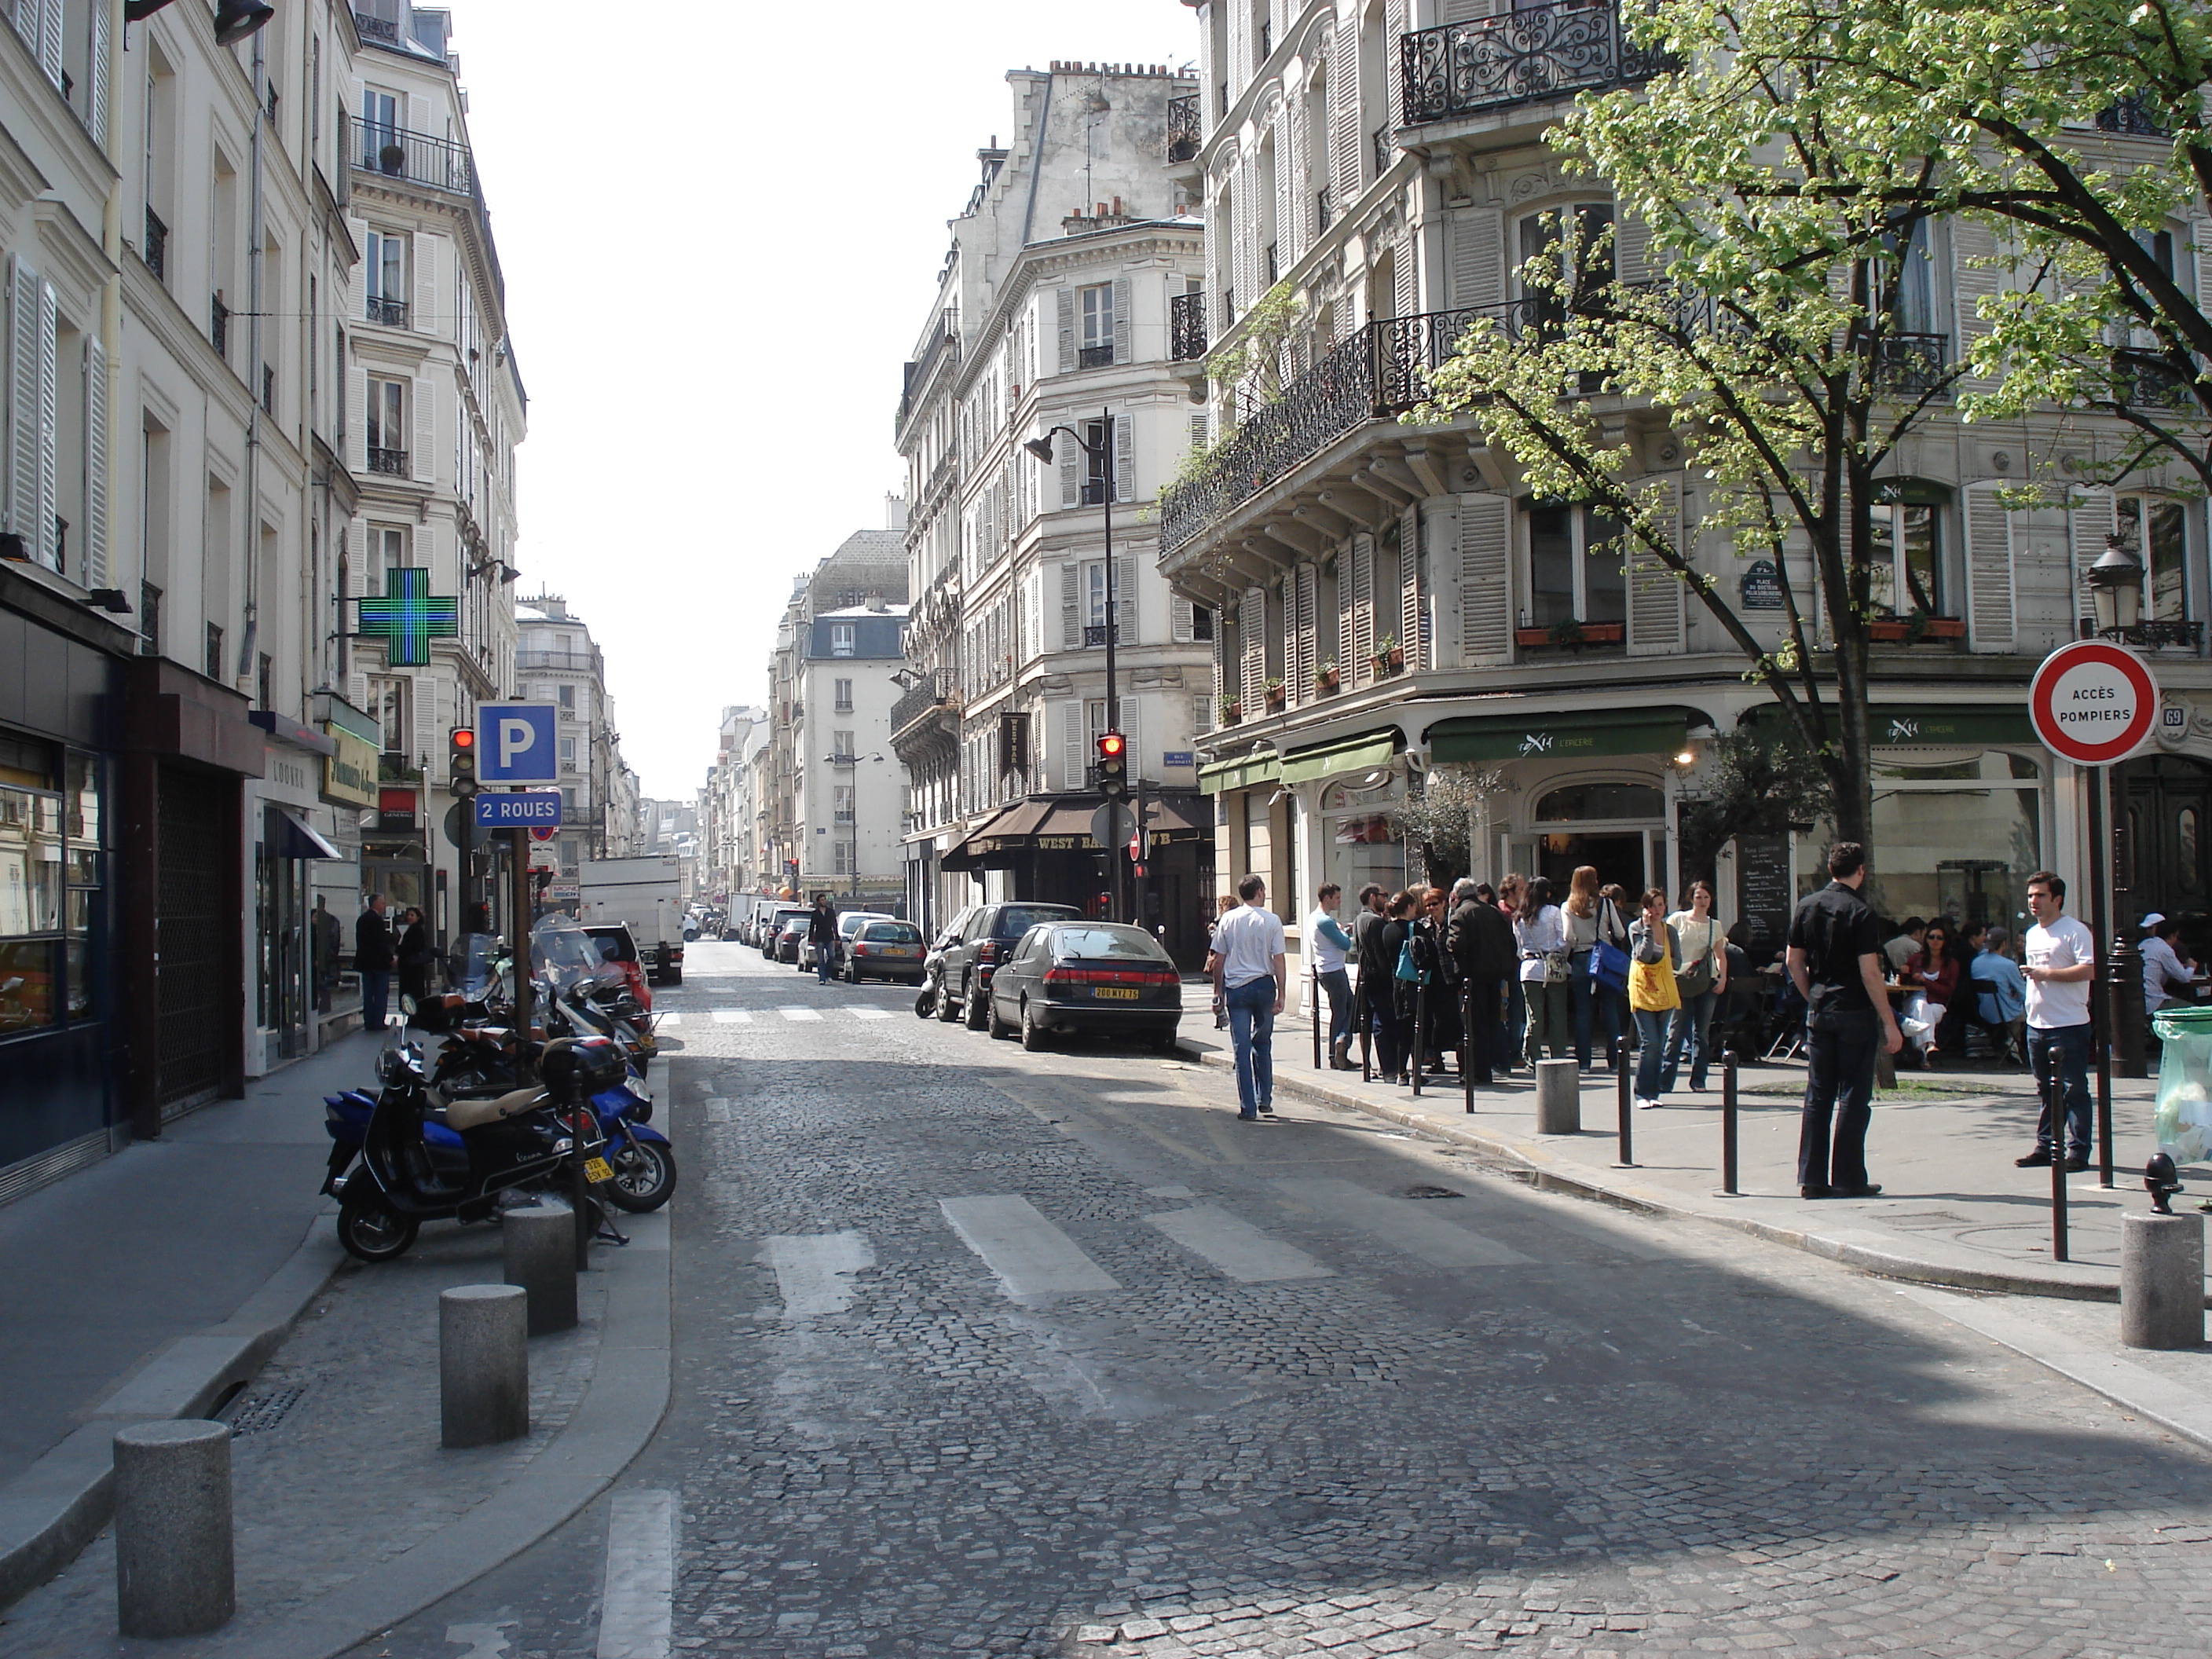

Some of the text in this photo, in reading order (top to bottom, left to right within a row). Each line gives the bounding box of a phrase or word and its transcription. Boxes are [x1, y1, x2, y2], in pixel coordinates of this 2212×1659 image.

[2072, 687, 2115, 700] ACCÈS
[2060, 709, 2130, 722] POMPIERS
[2166, 709, 2181, 724] 69
[500, 718, 536, 768] P
[273, 760, 304, 789] LOOKER
[482, 801, 555, 818] 2 ROUES
[1038, 837, 1106, 849] WEST BA
[1097, 987, 1111, 997] 200
[1129, 989, 1138, 998] 75
